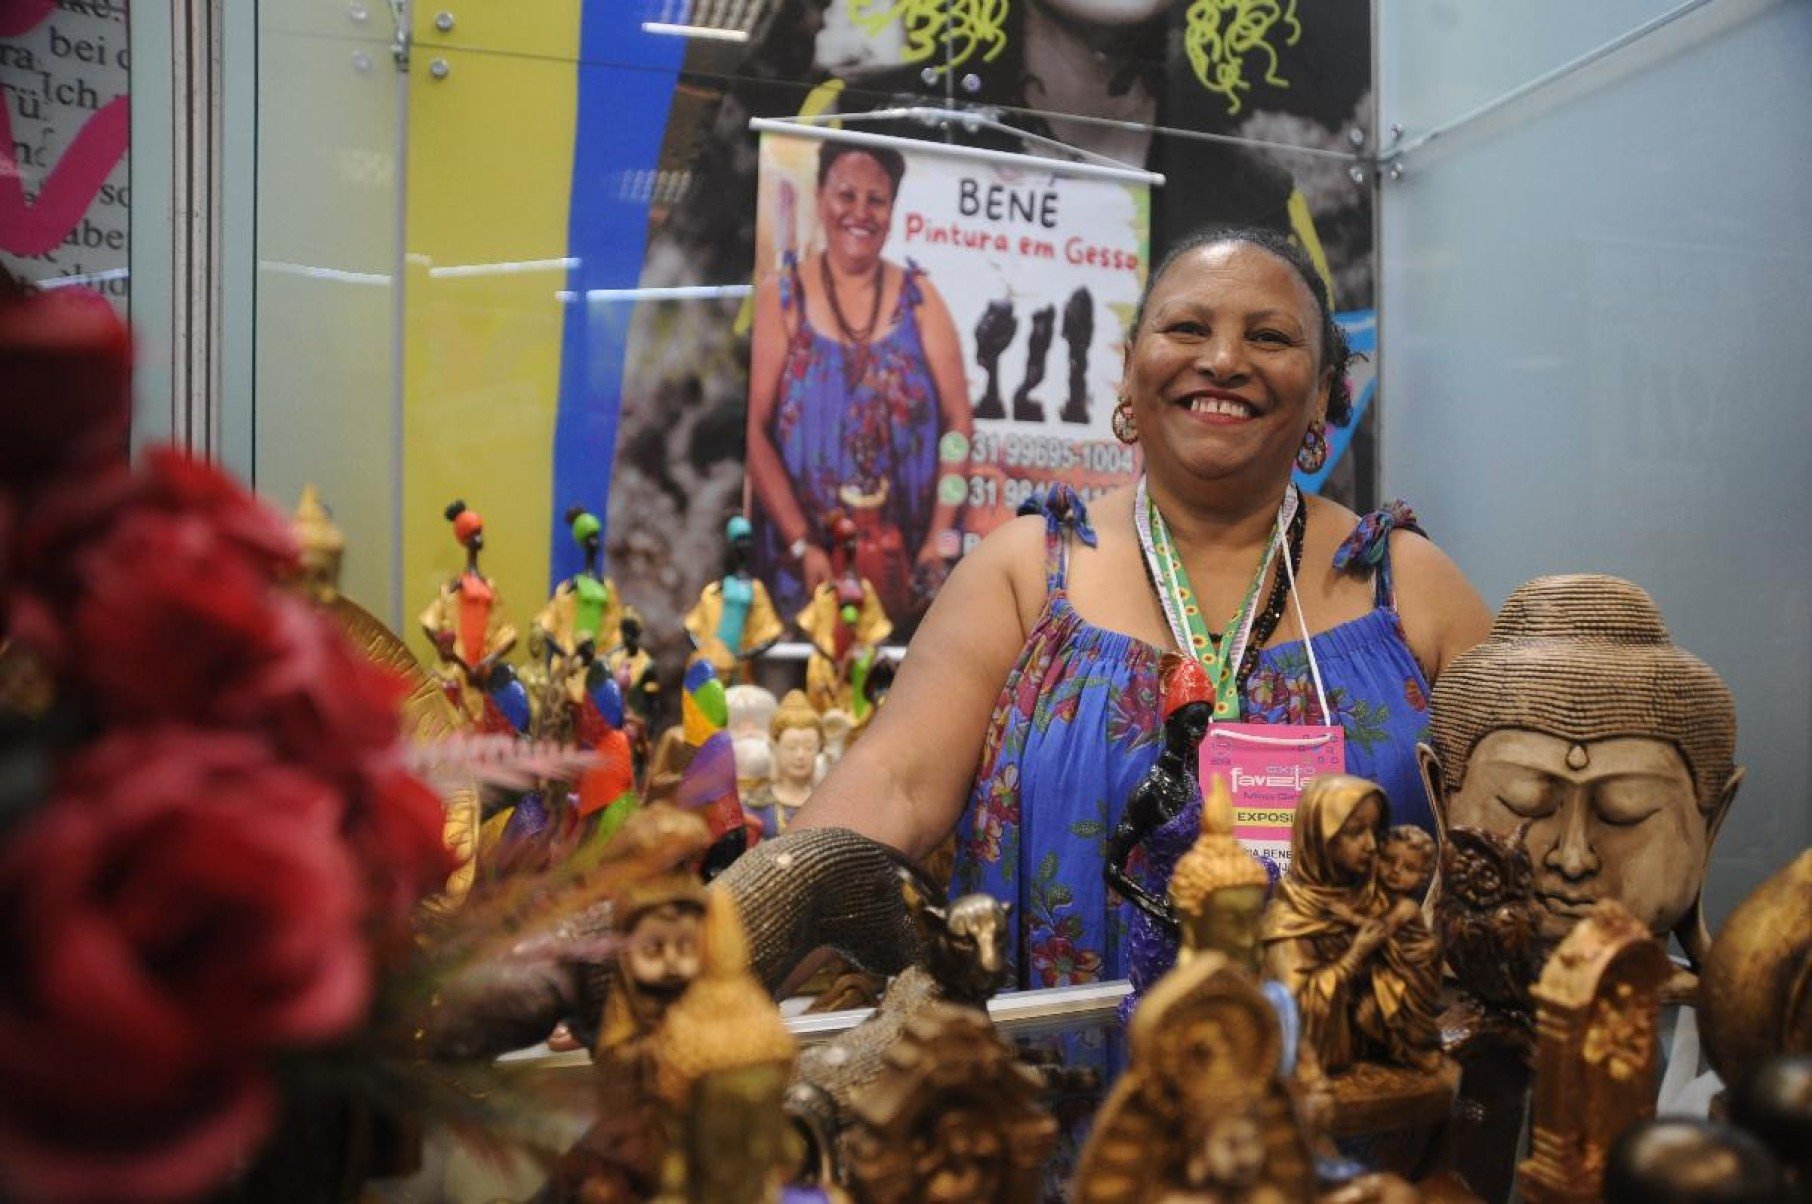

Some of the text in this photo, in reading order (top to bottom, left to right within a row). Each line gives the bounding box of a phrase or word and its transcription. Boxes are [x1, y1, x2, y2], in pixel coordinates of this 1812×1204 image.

[49, 25, 105, 66] bei
[38, 71, 98, 110] Ich
[905, 212, 1140, 271] Pintura em Gesso
[970, 431, 999, 465] 31
[968, 475, 997, 508] 31
